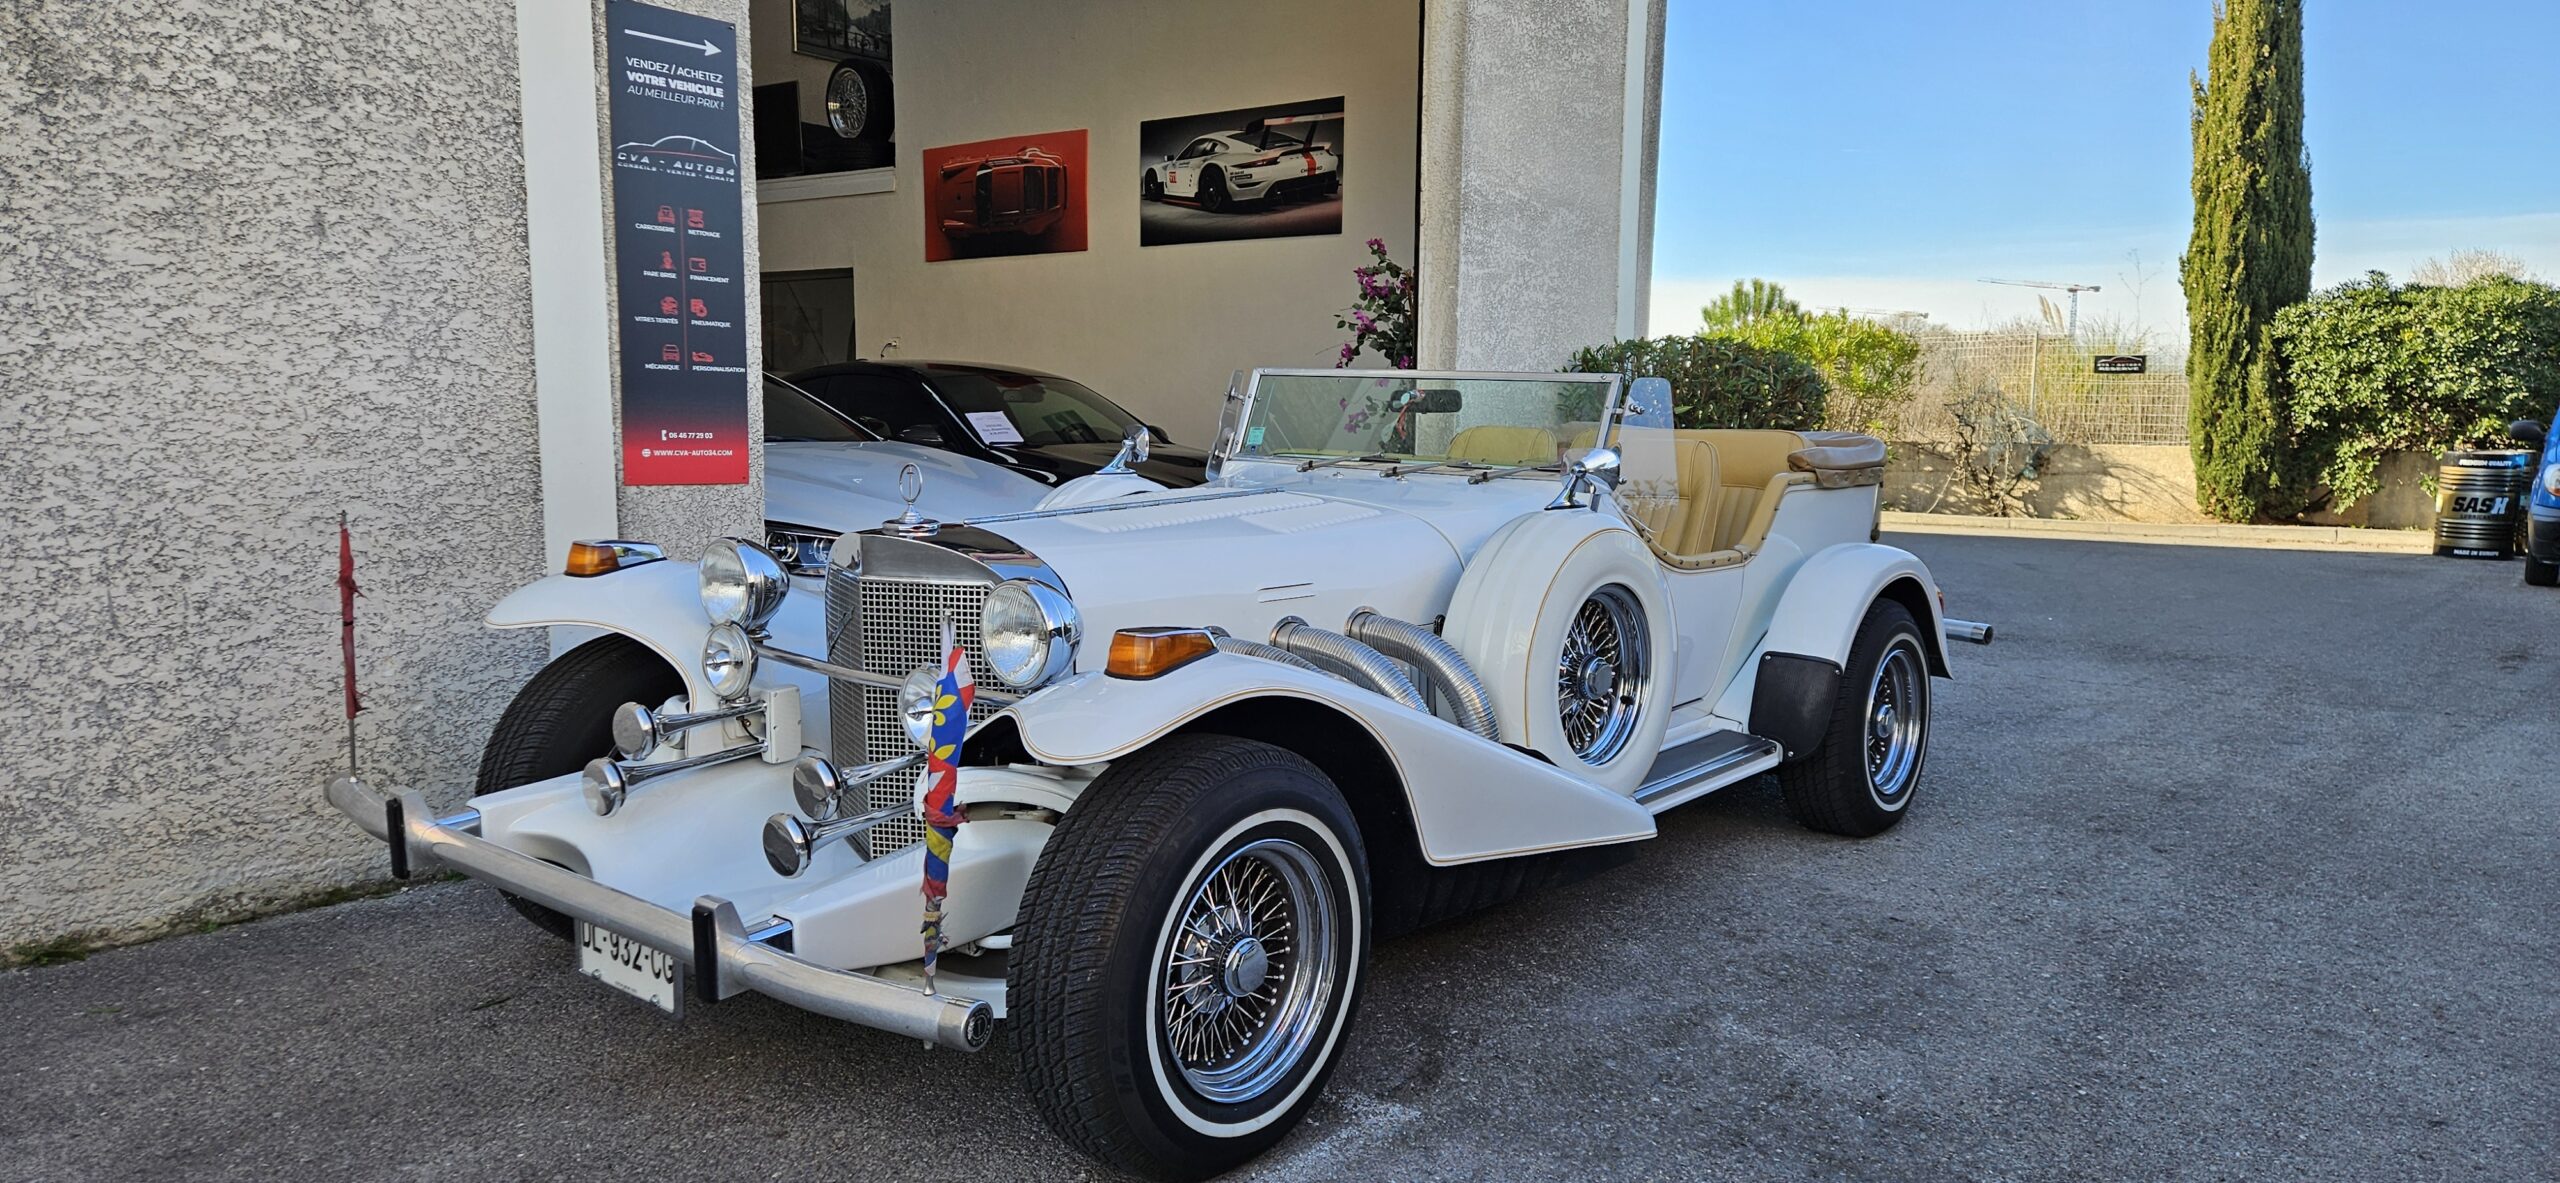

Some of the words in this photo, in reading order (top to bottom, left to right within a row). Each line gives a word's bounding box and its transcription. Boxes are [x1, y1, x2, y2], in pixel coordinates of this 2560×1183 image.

[625, 56, 670, 73] VENDEZ
[670, 64, 676, 75] /
[676, 67, 724, 84] ACHETEZ
[626, 70, 667, 87] VOTRE
[668, 78, 724, 98] VEHICULE
[627, 85, 643, 95] AU
[644, 88, 696, 104] MEILLEUR
[696, 97, 720, 110] PRIX
[617, 152, 650, 164] CVA
[688, 229, 721, 239] NETTOYAGE
[690, 274, 729, 283] FINANCEMENT
[691, 319, 731, 328] PNEUMATIQUE
[645, 362, 680, 371] MÉCANIQUE
[692, 365, 746, 373] PERSONNALISATION
[653, 449, 733, 457] WWW.CVA-AUTO34.COM
[2451, 496, 2510, 515] SASH
